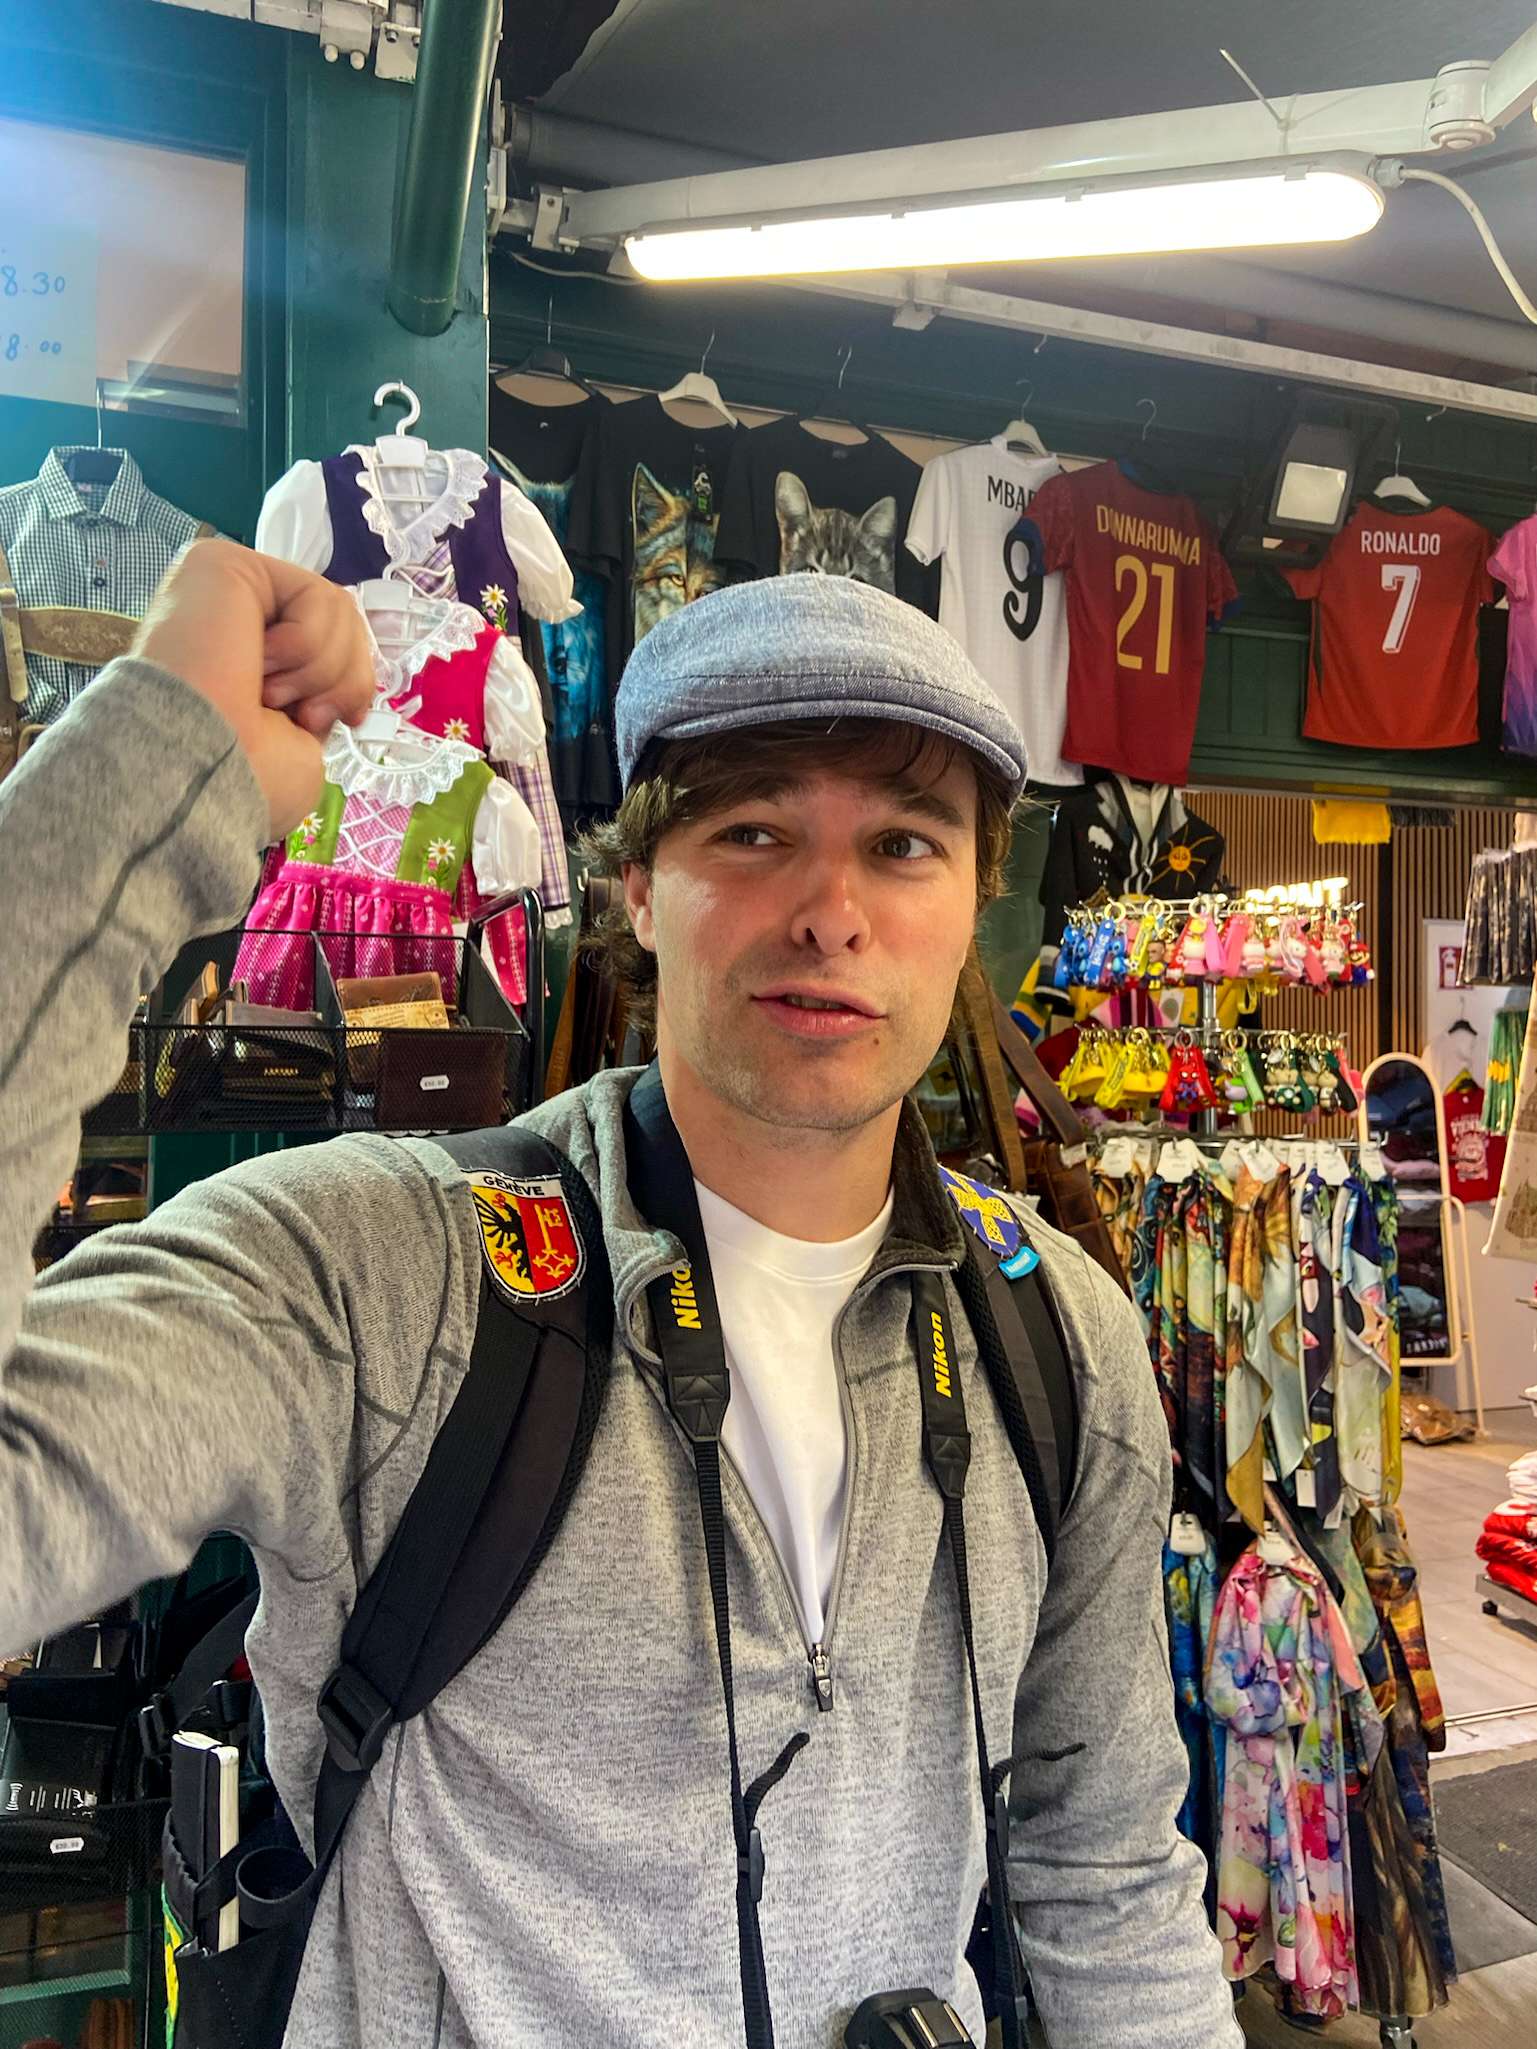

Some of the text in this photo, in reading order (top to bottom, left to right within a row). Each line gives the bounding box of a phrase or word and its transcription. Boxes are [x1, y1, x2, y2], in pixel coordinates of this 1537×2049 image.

[1003, 528, 1045, 642] 9
[1360, 530, 1441, 556] RONALDO
[1114, 554, 1175, 675] 21
[1381, 563, 1421, 654] 7
[931, 1311, 952, 1399] Nikon
